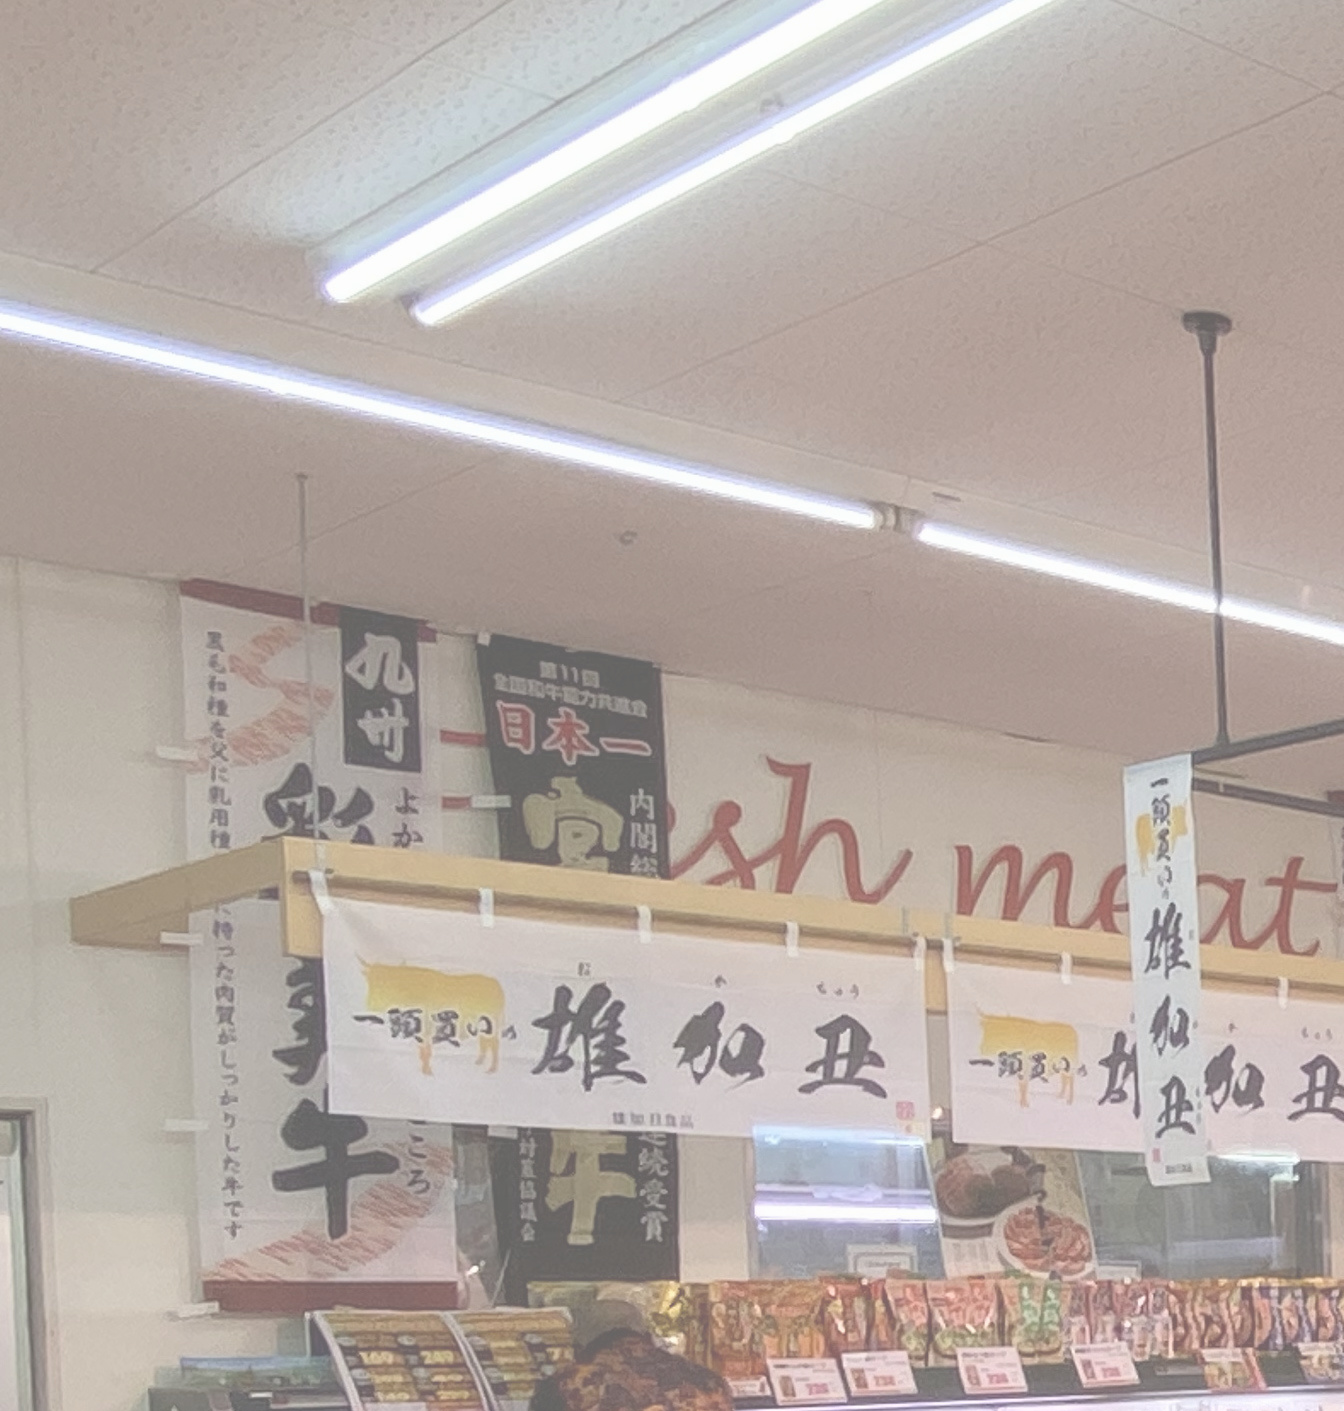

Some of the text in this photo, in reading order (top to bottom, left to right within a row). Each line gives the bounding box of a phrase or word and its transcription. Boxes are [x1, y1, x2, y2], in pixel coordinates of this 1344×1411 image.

[345, 632, 416, 763] 九州
[496, 700, 653, 766] 日本一
[353, 1005, 520, 1048] 一頭買いの
